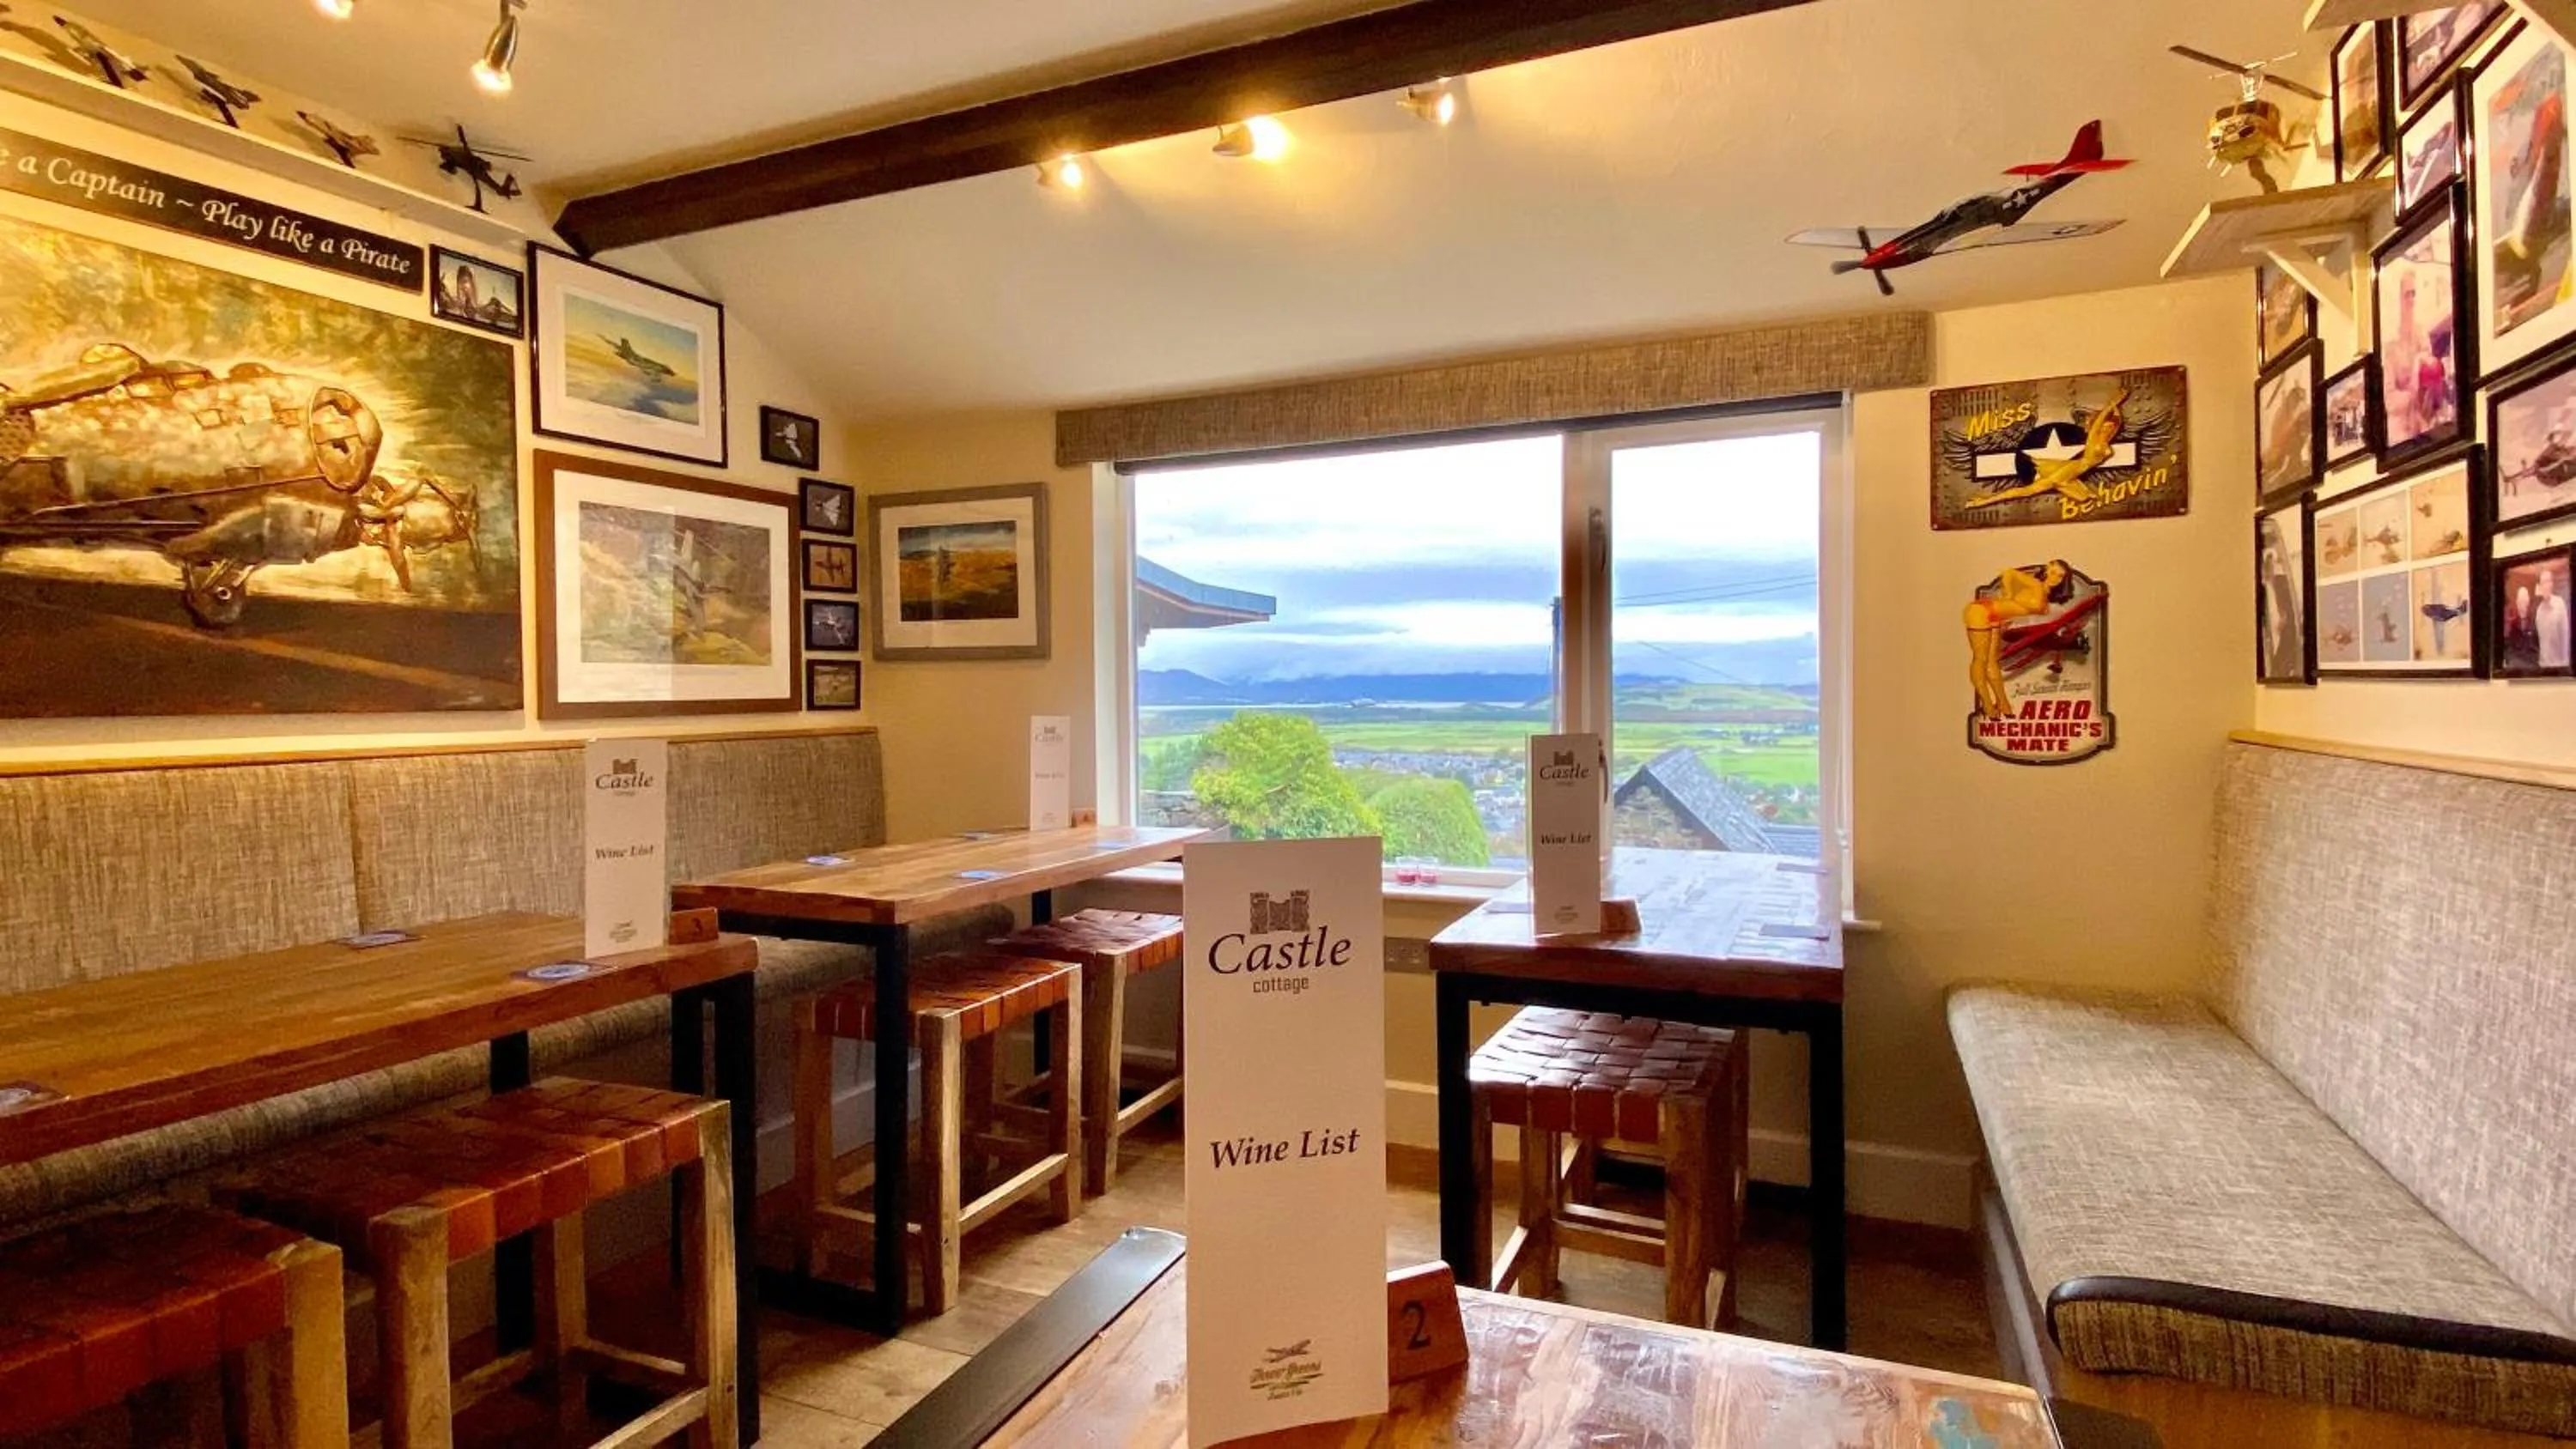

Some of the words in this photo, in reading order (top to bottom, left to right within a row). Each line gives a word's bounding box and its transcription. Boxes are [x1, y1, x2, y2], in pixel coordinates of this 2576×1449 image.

[17, 155, 38, 174] a
[47, 157, 166, 209] Captain
[200, 199, 263, 240] Play
[270, 215, 314, 253] like
[320, 237, 335, 254] a
[341, 238, 410, 275] Pirate
[1966, 402, 2032, 441] Miss
[2019, 700, 2092, 719] AERO
[1978, 722, 2102, 737] MECHANIC'S
[2006, 739, 2069, 751] MATE
[595, 772, 653, 790] Castle
[1540, 763, 1590, 780] Castle
[1207, 925, 1352, 975] Castle
[1252, 975, 1309, 995] cottage
[1209, 1137, 1290, 1169] Wine
[1299, 1127, 1361, 1159] List
[1399, 1299, 1431, 1350] 2
